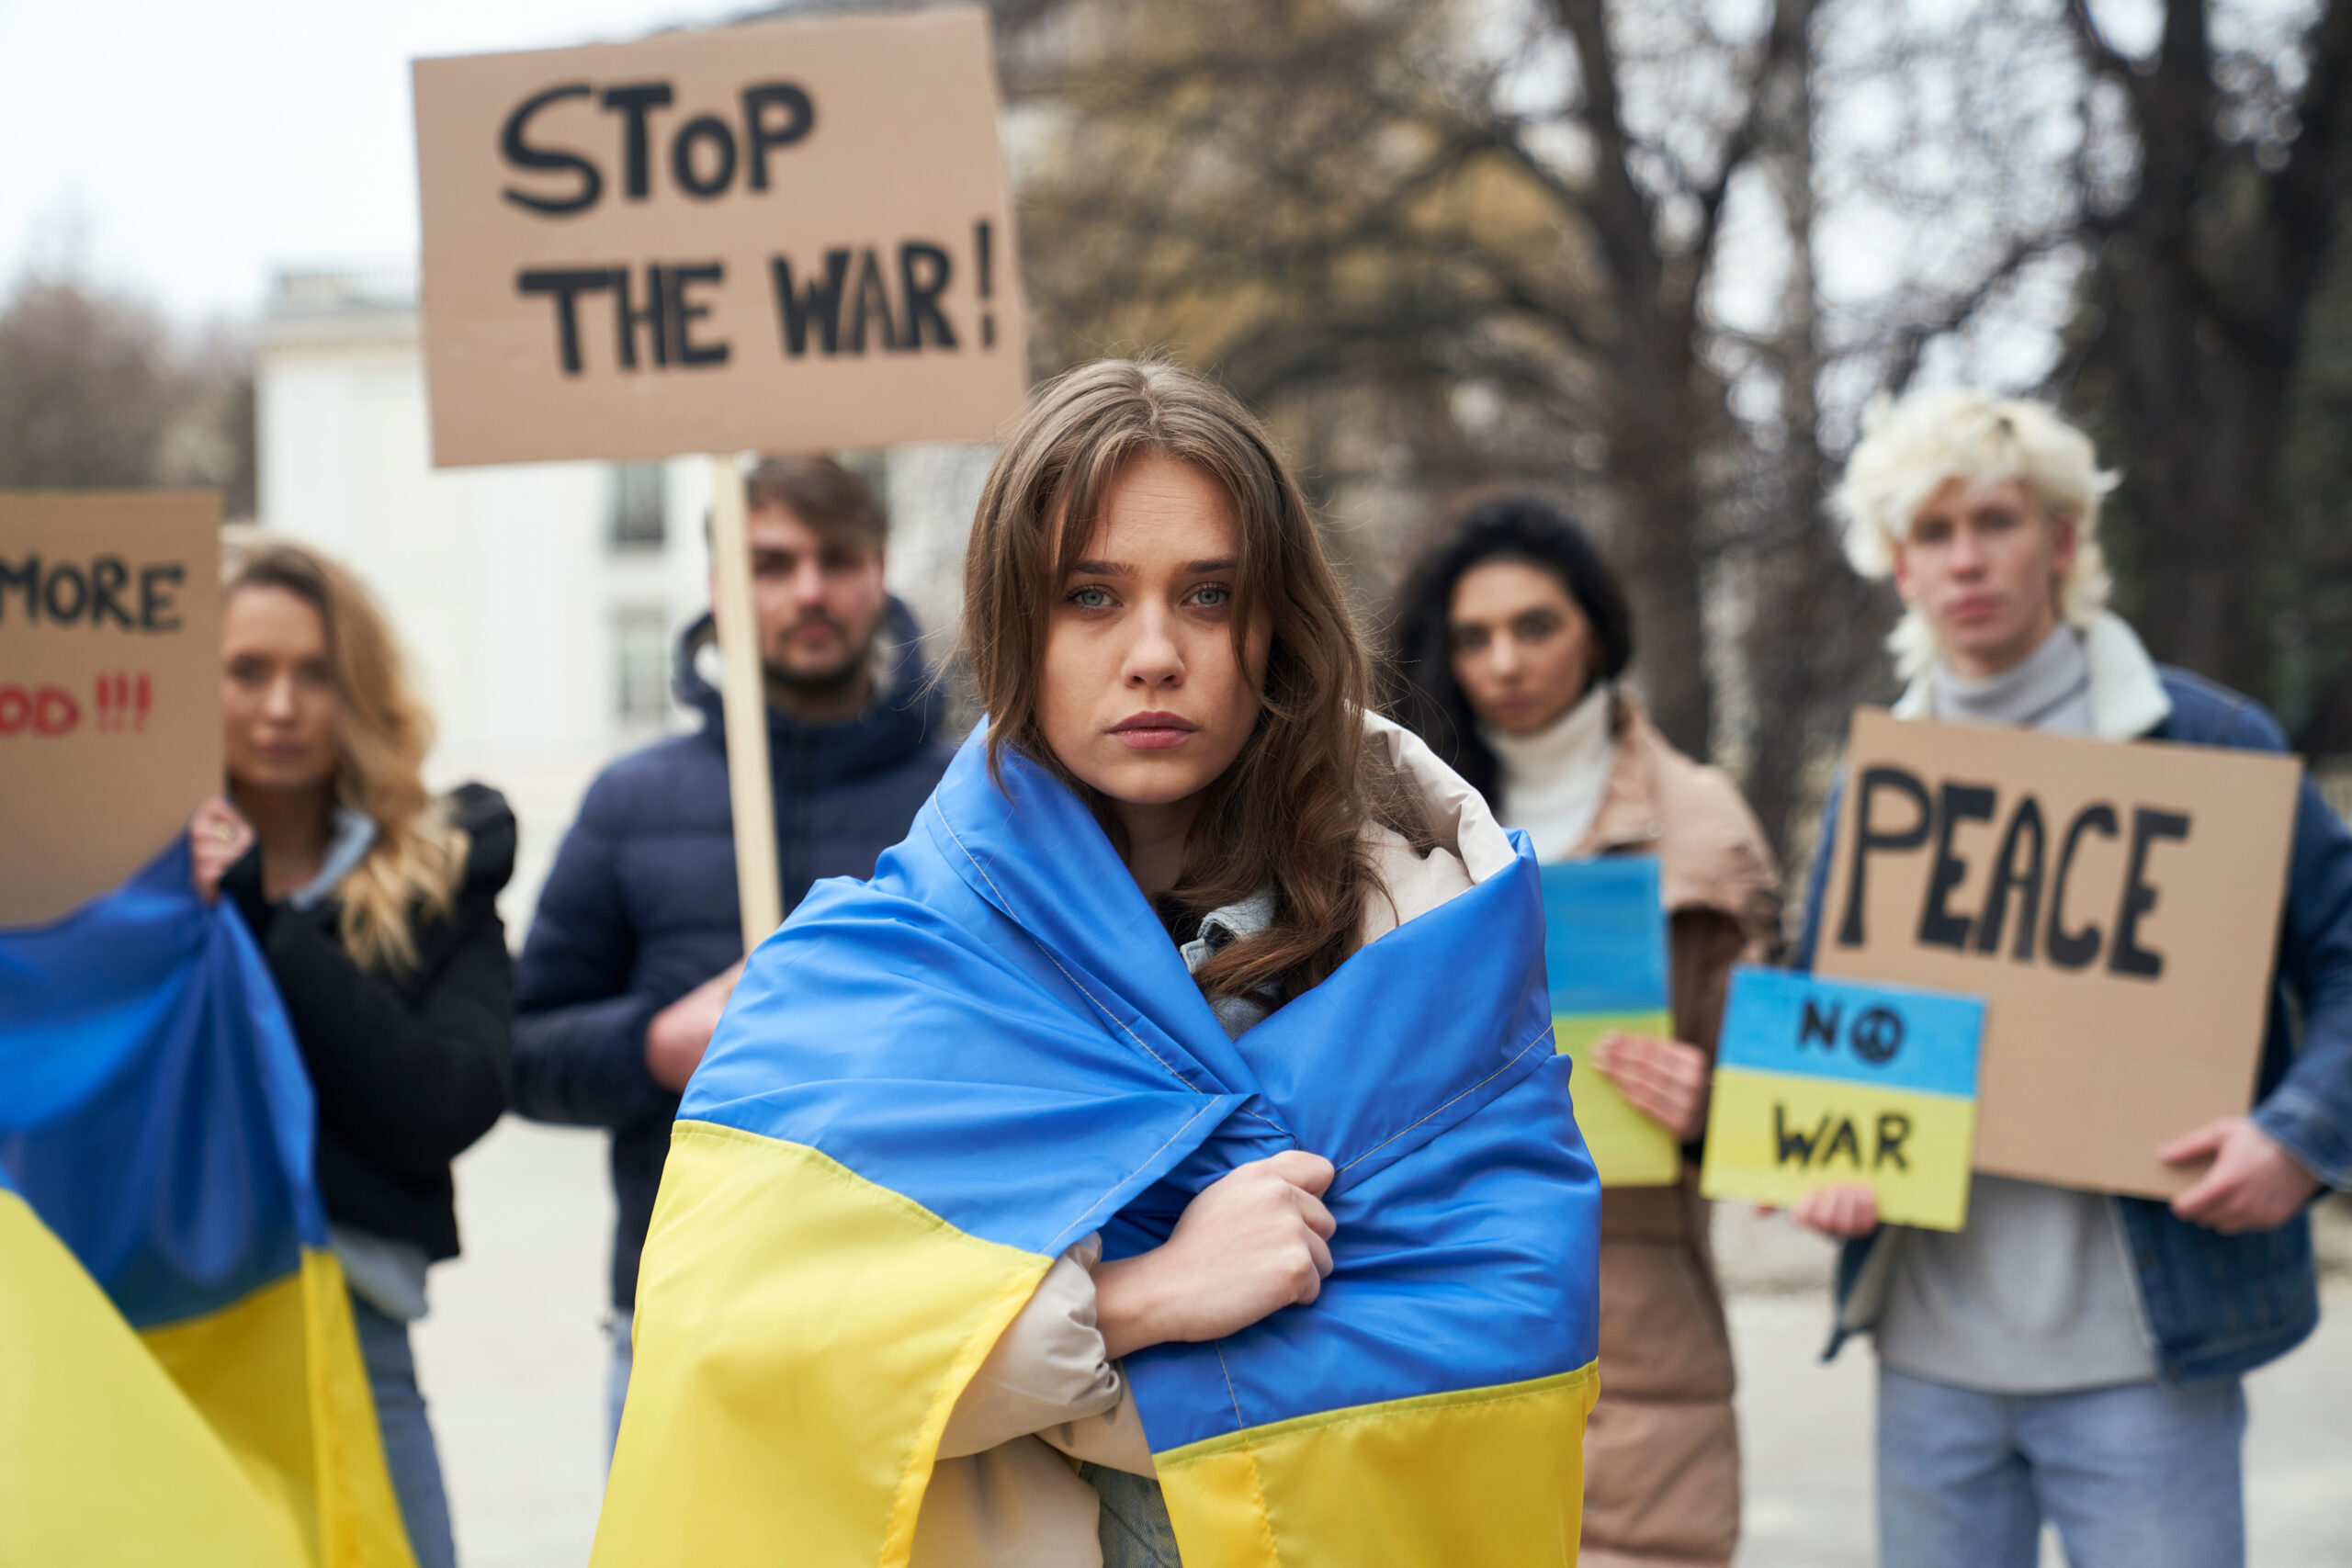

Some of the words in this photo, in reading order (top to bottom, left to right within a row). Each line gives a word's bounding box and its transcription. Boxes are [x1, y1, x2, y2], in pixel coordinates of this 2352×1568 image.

[499, 80, 816, 217] STOP
[515, 261, 731, 376] THE
[768, 219, 995, 359] WAR!
[0, 551, 187, 634] MORE
[1837, 765, 2192, 981] PEACE
[1773, 1102, 1912, 1171] WAR
